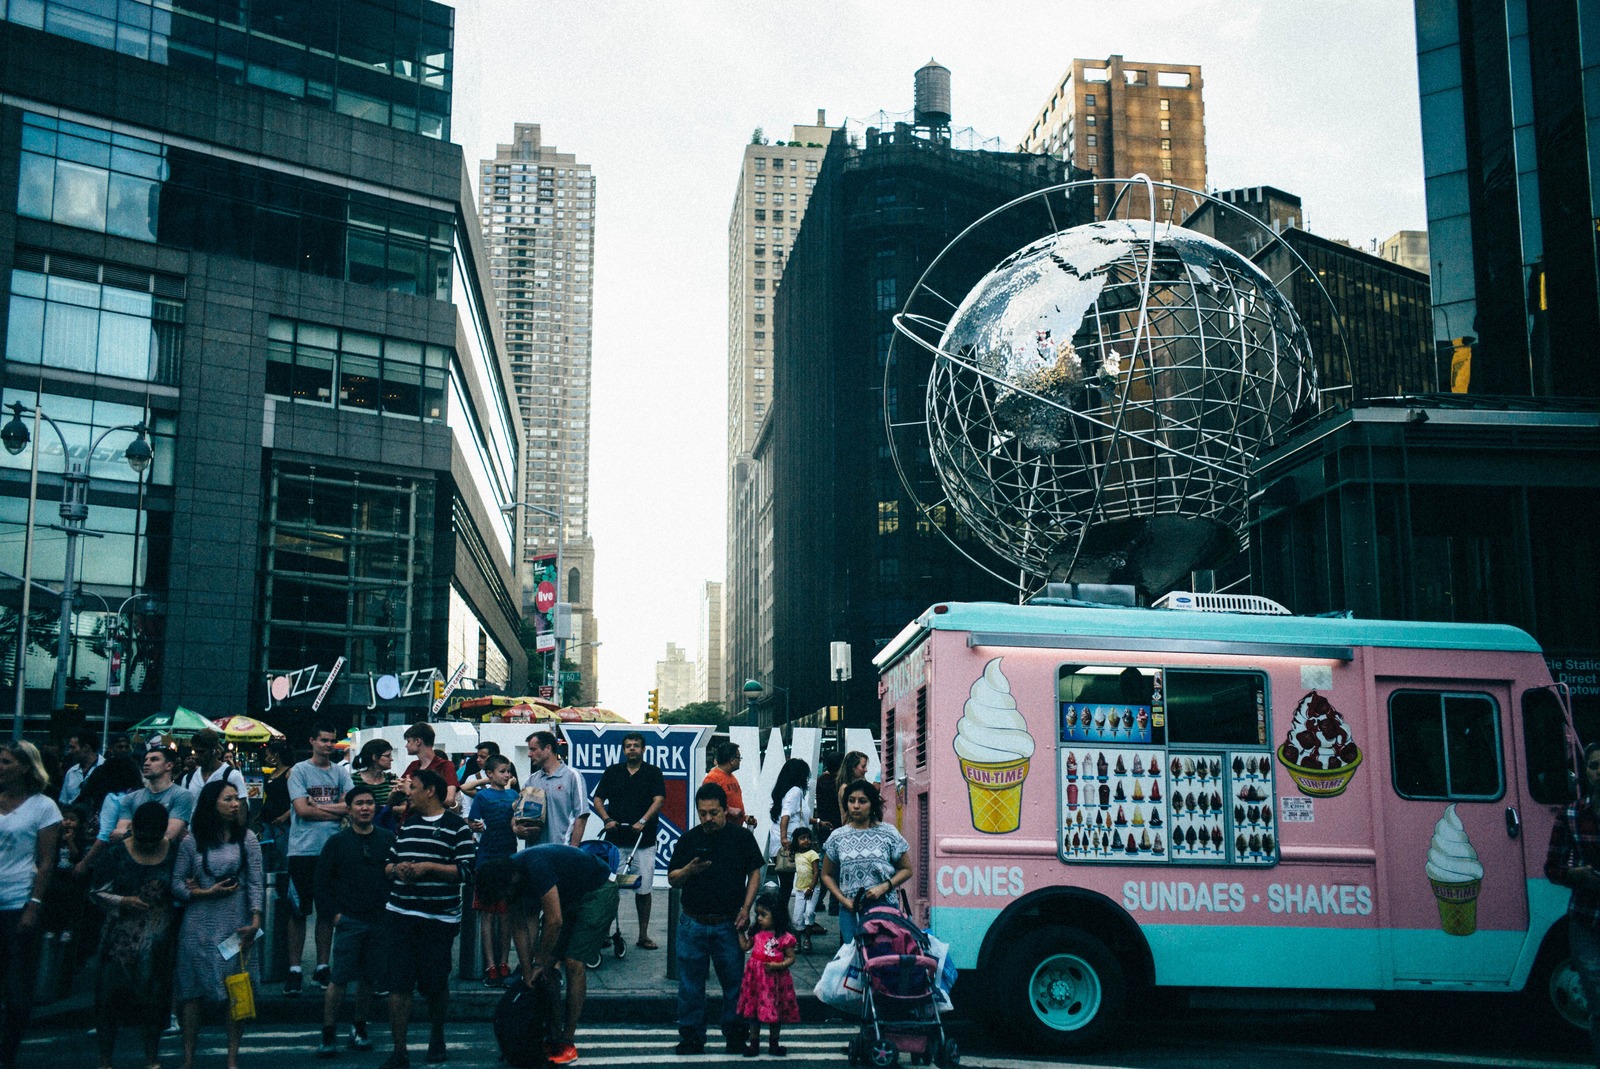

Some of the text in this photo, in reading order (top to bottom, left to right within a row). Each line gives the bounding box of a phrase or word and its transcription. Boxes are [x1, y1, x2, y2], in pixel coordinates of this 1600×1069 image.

[538, 591, 553, 602] live
[1565, 659, 1600, 671] Statio
[566, 673, 575, 681] 60
[264, 664, 323, 712] jazz
[1560, 685, 1600, 695] Uptow
[576, 744, 686, 770] NEW ORK
[965, 765, 1024, 784] FUN-TIME
[1298, 776, 1346, 790] FUN-TIME
[936, 865, 1025, 897] CONES
[1123, 880, 1373, 916] SUNDAES SHAKES
